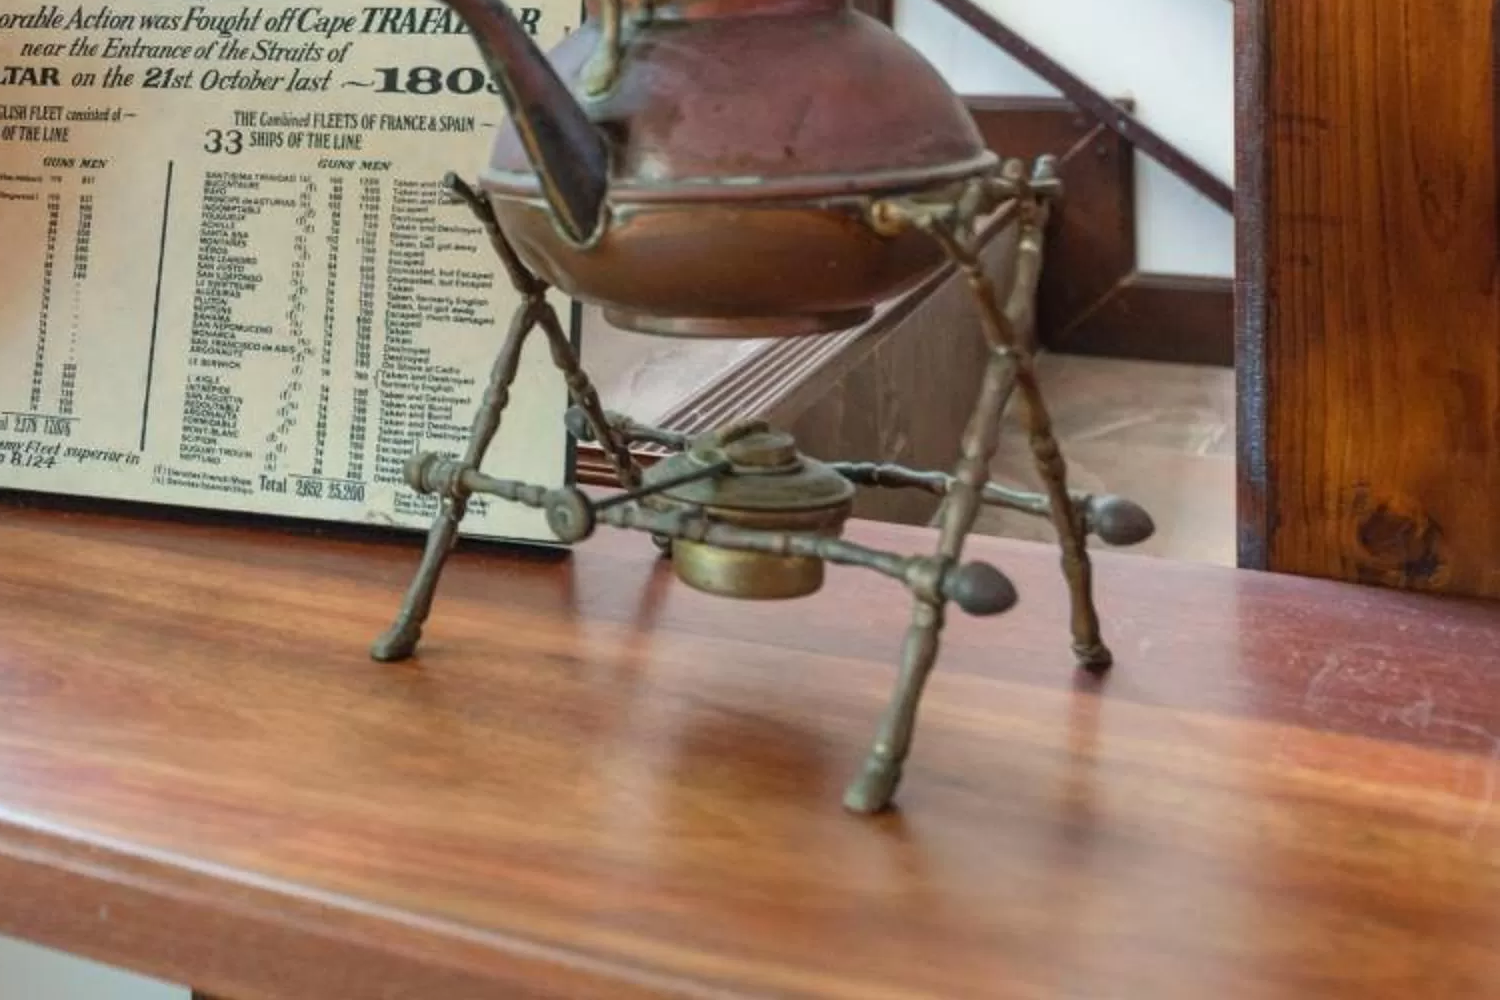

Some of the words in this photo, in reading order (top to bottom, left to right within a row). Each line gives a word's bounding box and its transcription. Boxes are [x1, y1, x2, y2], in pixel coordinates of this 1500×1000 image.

[62, 4, 137, 32] Action
[138, 12, 180, 31] was
[180, 5, 260, 38] Fought
[264, 6, 303, 34] off
[297, 7, 358, 39] Cape
[20, 41, 66, 59] near
[68, 36, 99, 59] the
[101, 37, 194, 60] Entrance
[194, 38, 220, 64] of
[219, 40, 246, 62] the
[250, 39, 325, 64] Straits
[327, 41, 353, 65] of
[71, 70, 97, 88] on
[100, 65, 135, 89] the
[140, 66, 194, 90] 21st
[199, 68, 286, 93] October
[285, 66, 334, 93] last
[29, 105, 64, 121] FLEET
[234, 110, 257, 127] THE
[260, 112, 311, 128] Combined
[313, 113, 358, 129] FLEETS
[360, 114, 378, 130] OF
[380, 114, 427, 131] FRANCE
[439, 115, 475, 132] SPAIN
[1, 126, 17, 141] OF
[19, 126, 40, 141] THE
[42, 127, 69, 142] LINE
[203, 129, 244, 155] 33
[249, 131, 284, 148] SHIPS
[287, 132, 305, 149] OF
[307, 133, 331, 149] THE
[333, 134, 363, 150] LINE
[317, 158, 357, 170] GUNS
[360, 160, 393, 171] MEN
[25, 440, 61, 455] Fleet
[63, 445, 125, 464] superior
[125, 450, 141, 465] in
[259, 474, 287, 494] Total
